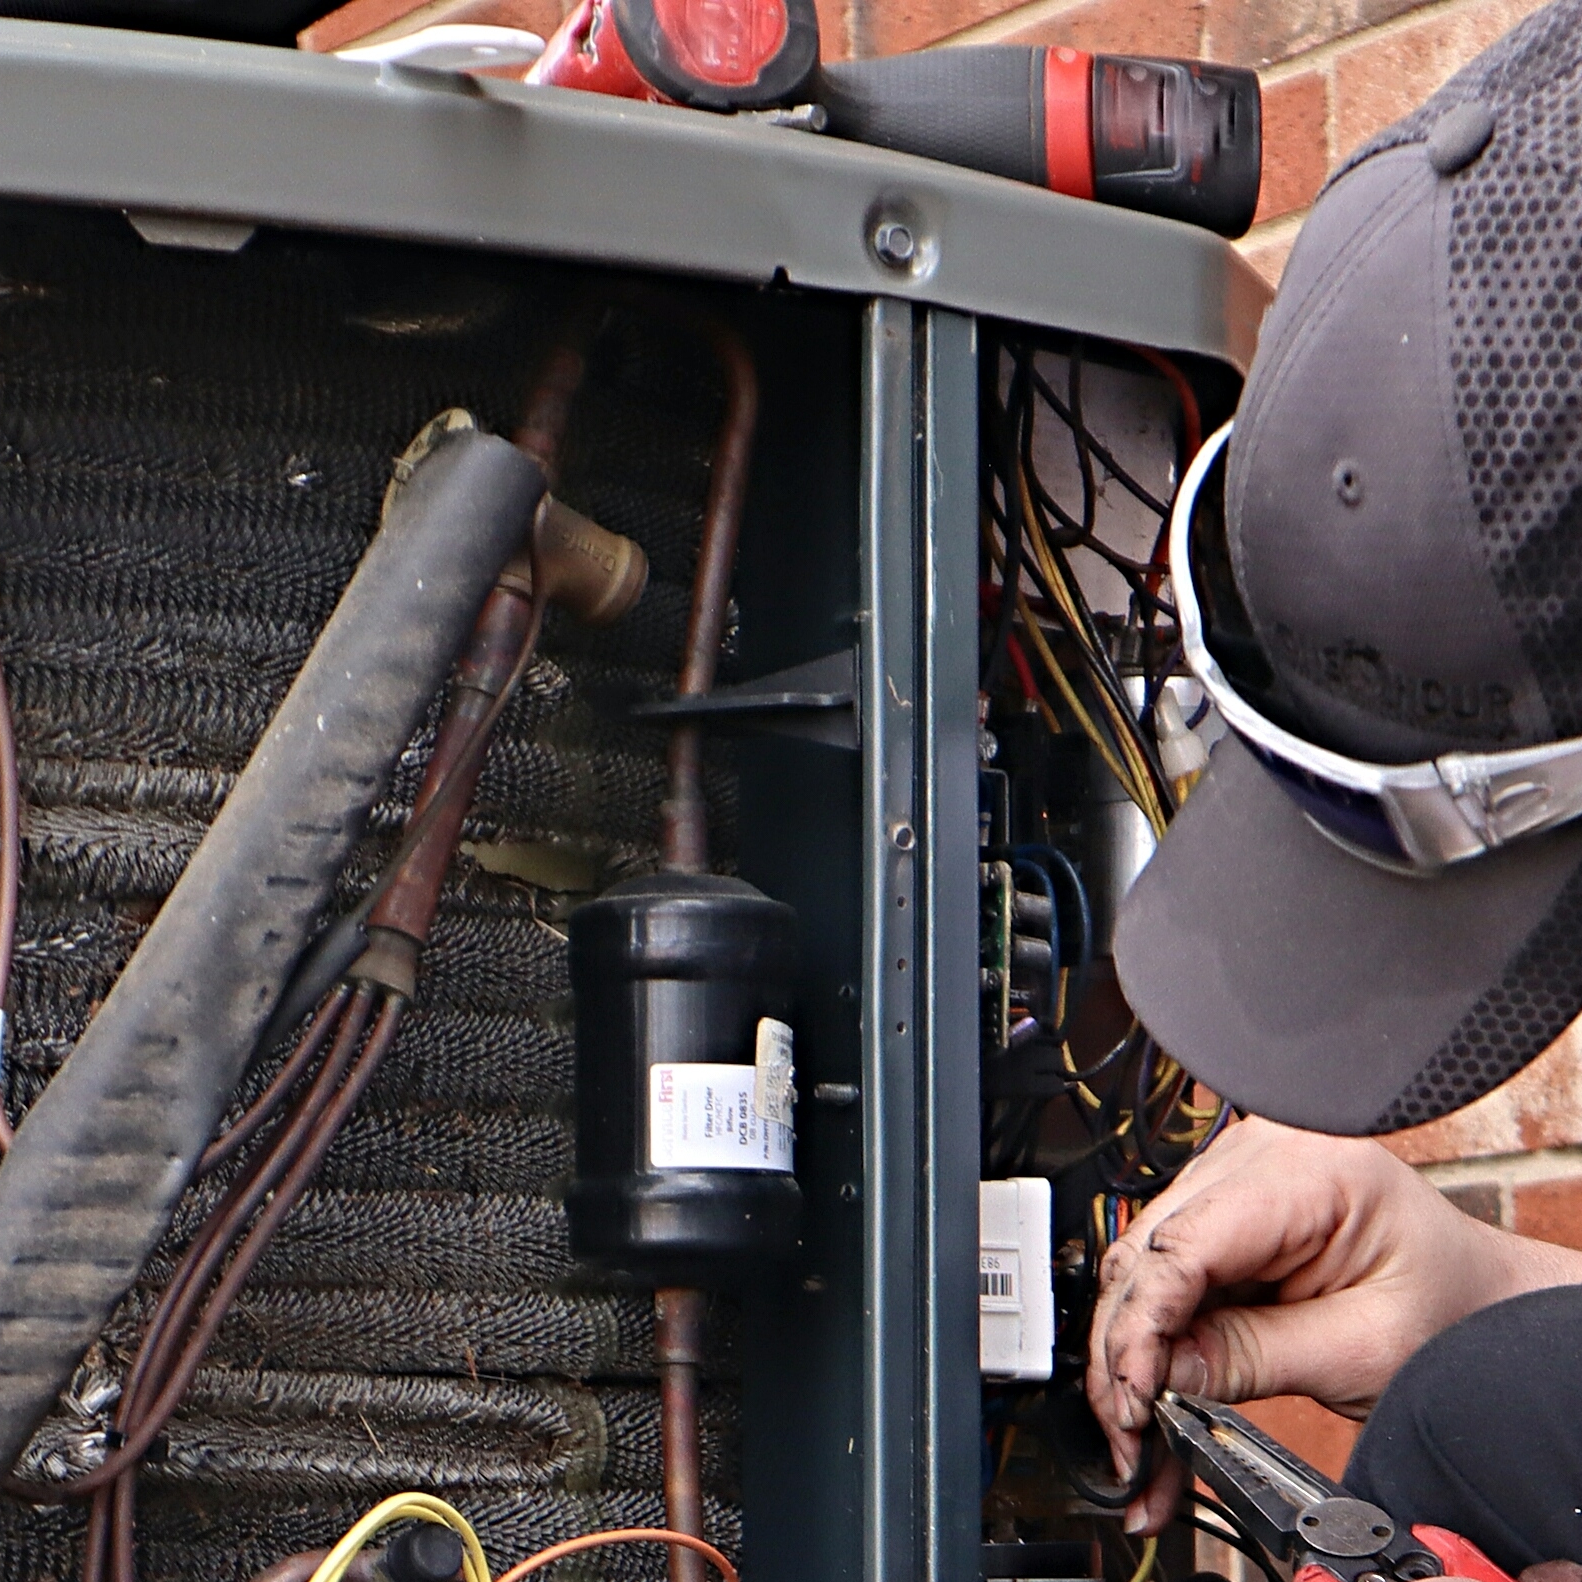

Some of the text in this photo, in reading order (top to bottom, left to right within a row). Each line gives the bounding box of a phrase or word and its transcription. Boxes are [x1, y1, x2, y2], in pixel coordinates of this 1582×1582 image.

[705, 1086, 713, 1138] Filter Drier
[739, 1122, 748, 1145] DCB
